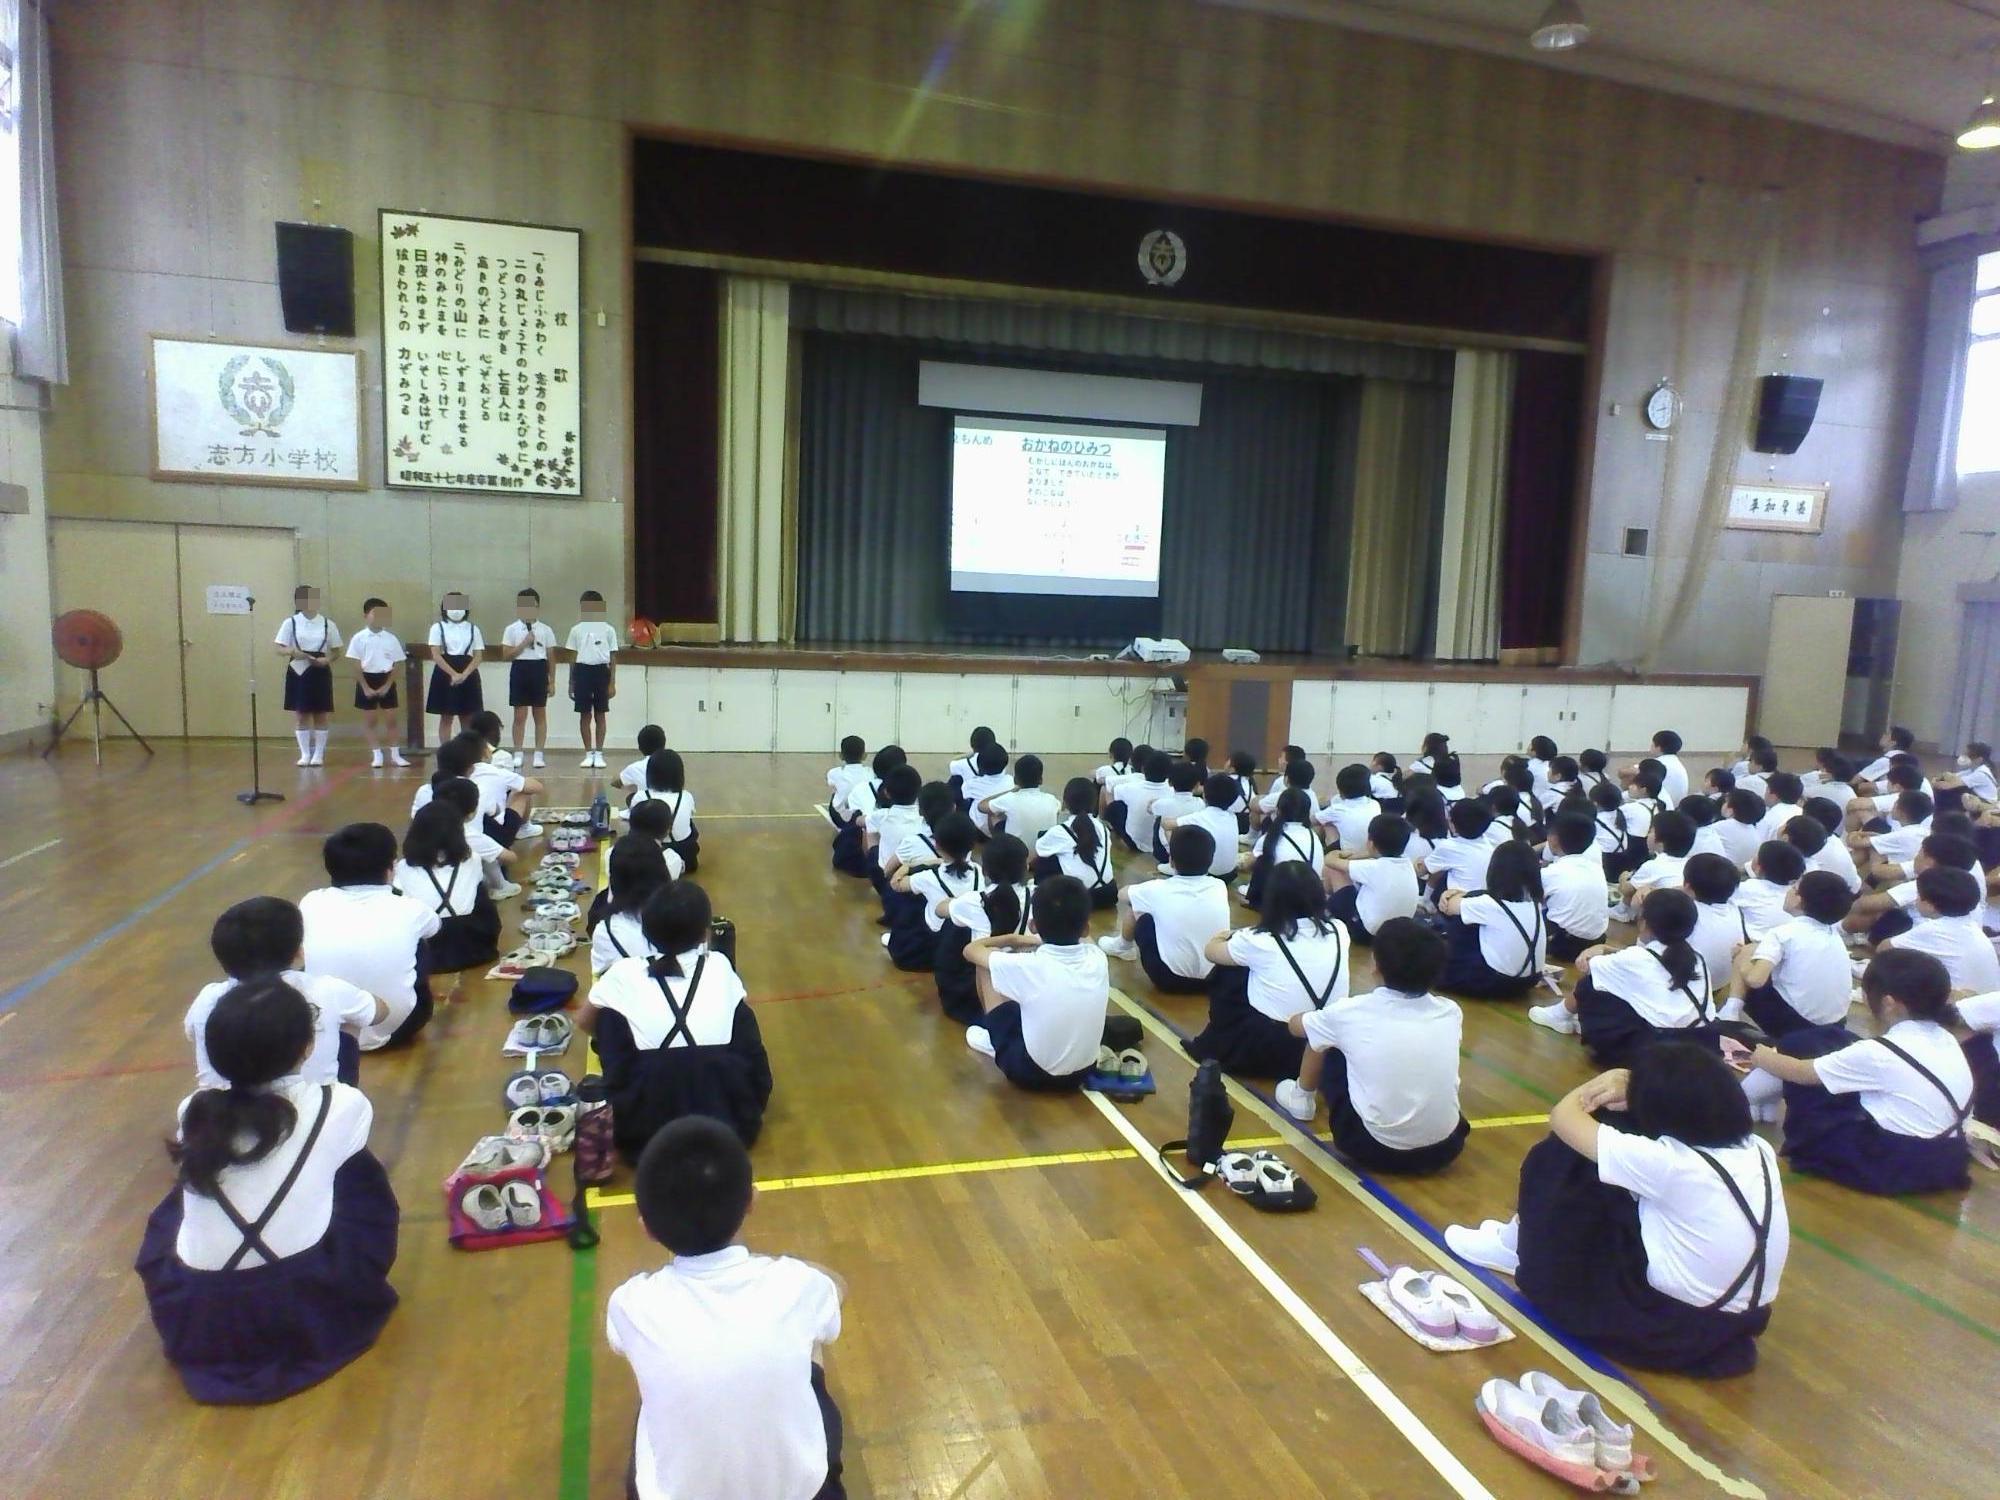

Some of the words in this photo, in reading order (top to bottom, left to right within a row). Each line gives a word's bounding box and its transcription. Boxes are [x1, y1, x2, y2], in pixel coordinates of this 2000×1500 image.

[398, 347, 412, 416] 力ぞみつる
[437, 351, 451, 419] 心にうけて
[497, 369, 512, 423] 七百人は
[207, 444, 338, 473] 志方小学校
[1022, 438, 1111, 456] おかねのひみつ
